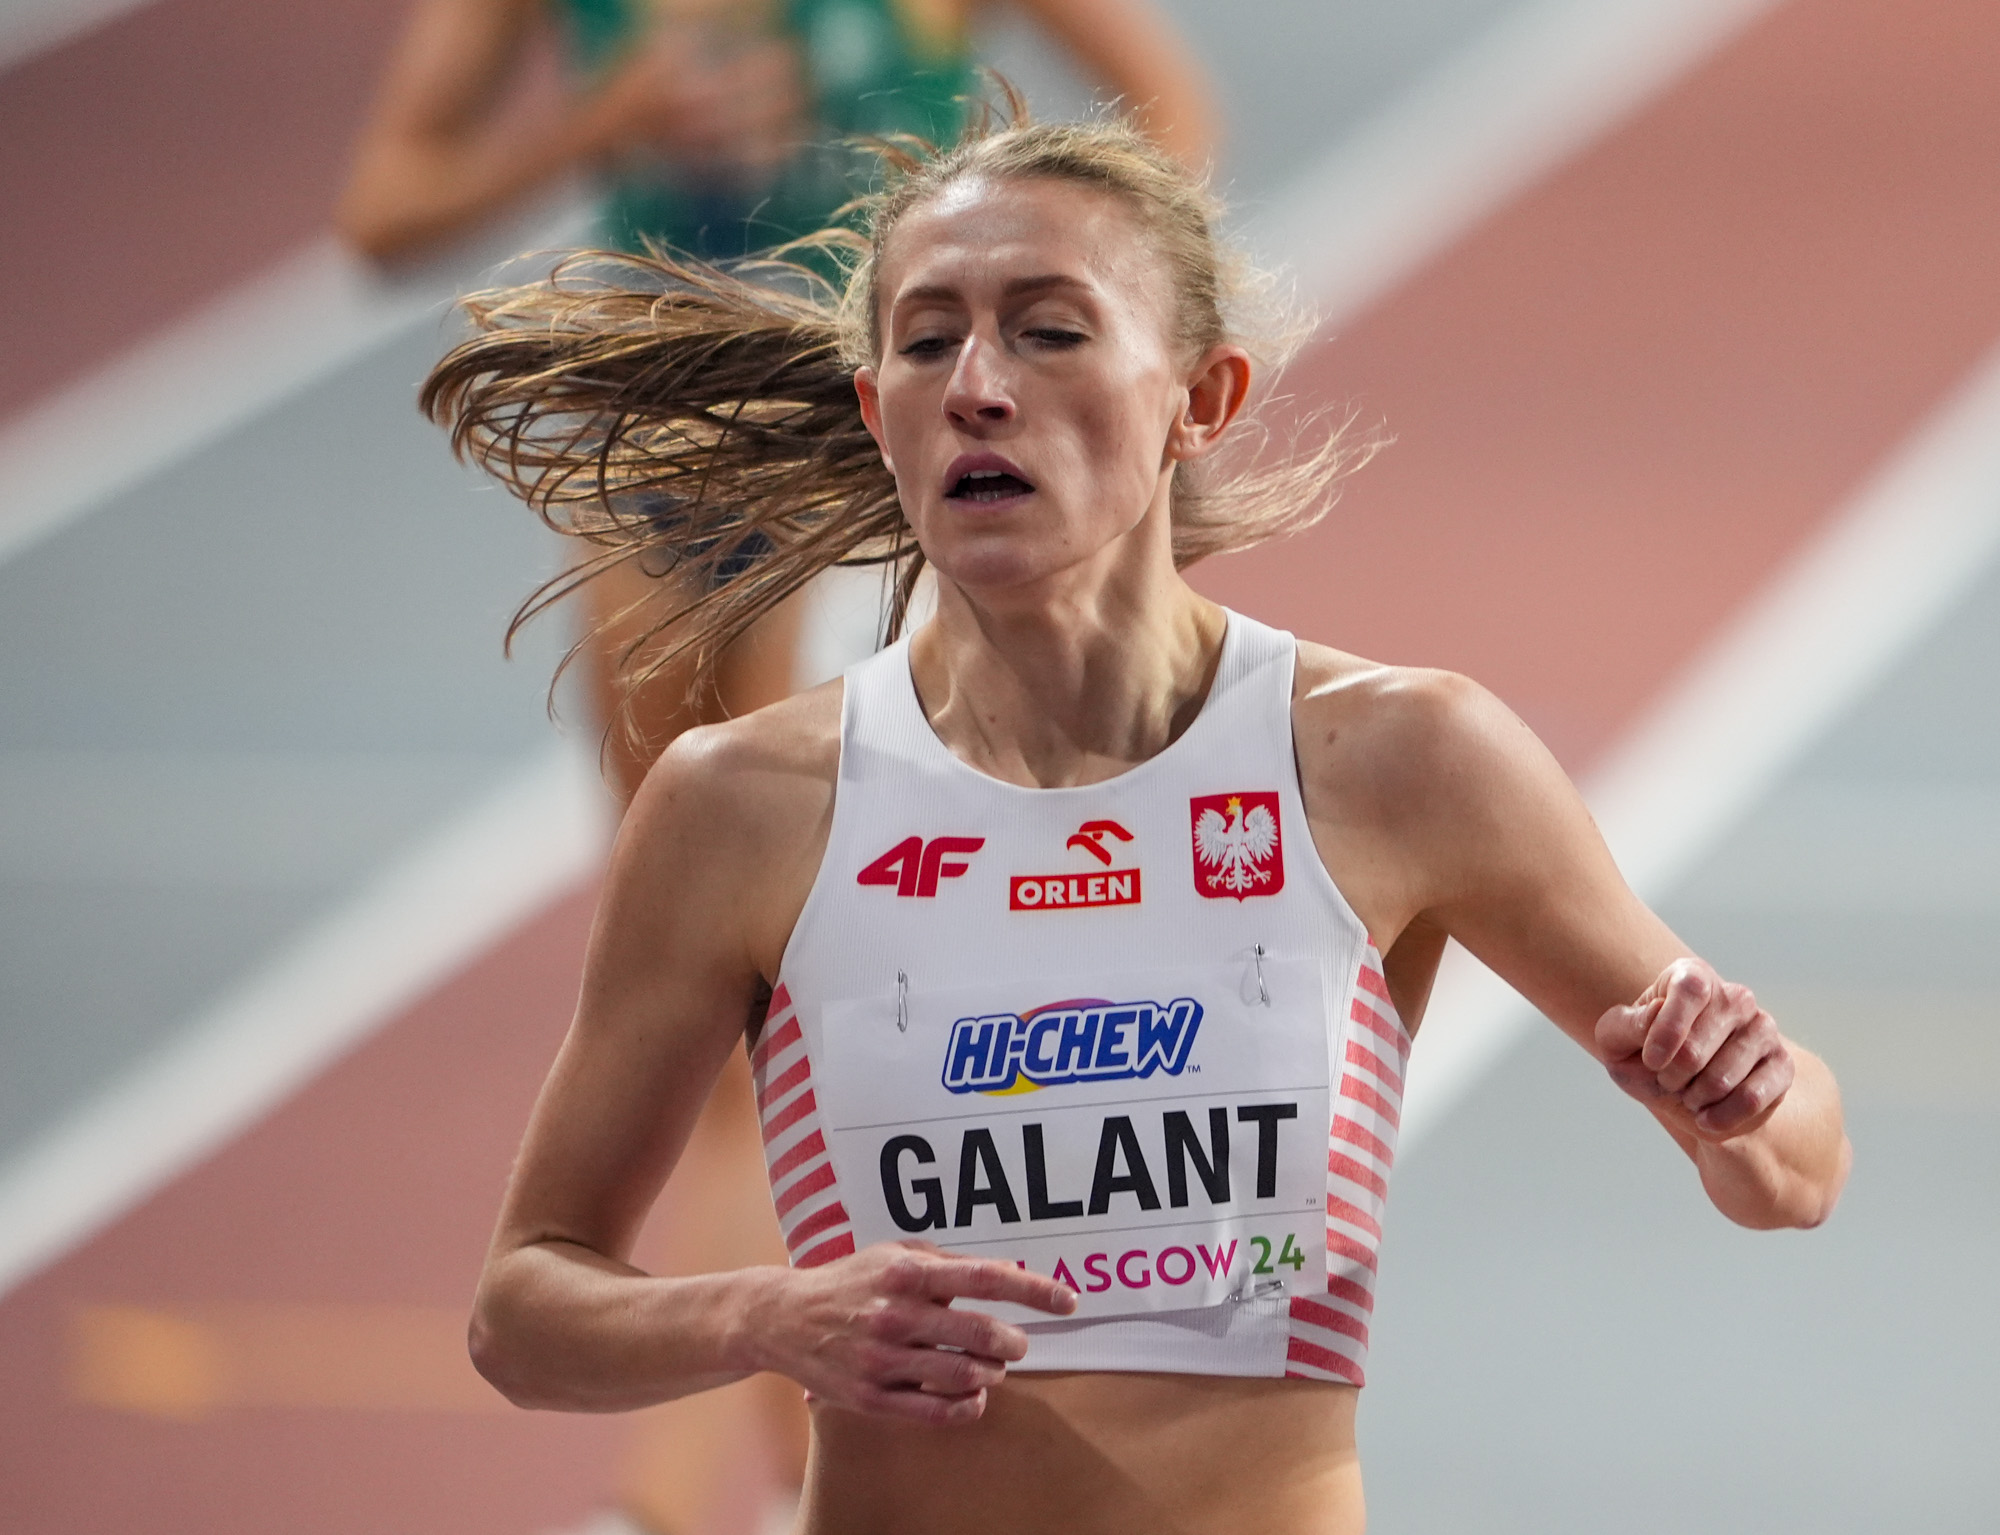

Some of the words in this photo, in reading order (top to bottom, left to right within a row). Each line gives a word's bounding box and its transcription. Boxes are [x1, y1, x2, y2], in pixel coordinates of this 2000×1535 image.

[857, 836, 985, 897] 4F
[1017, 874, 1132, 906] ORLEN
[942, 997, 1204, 1094] HI-CHEW
[879, 1103, 1298, 1233] GALANT
[1016, 1239, 1238, 1294] ASGOW
[1250, 1233, 1306, 1275] 24
